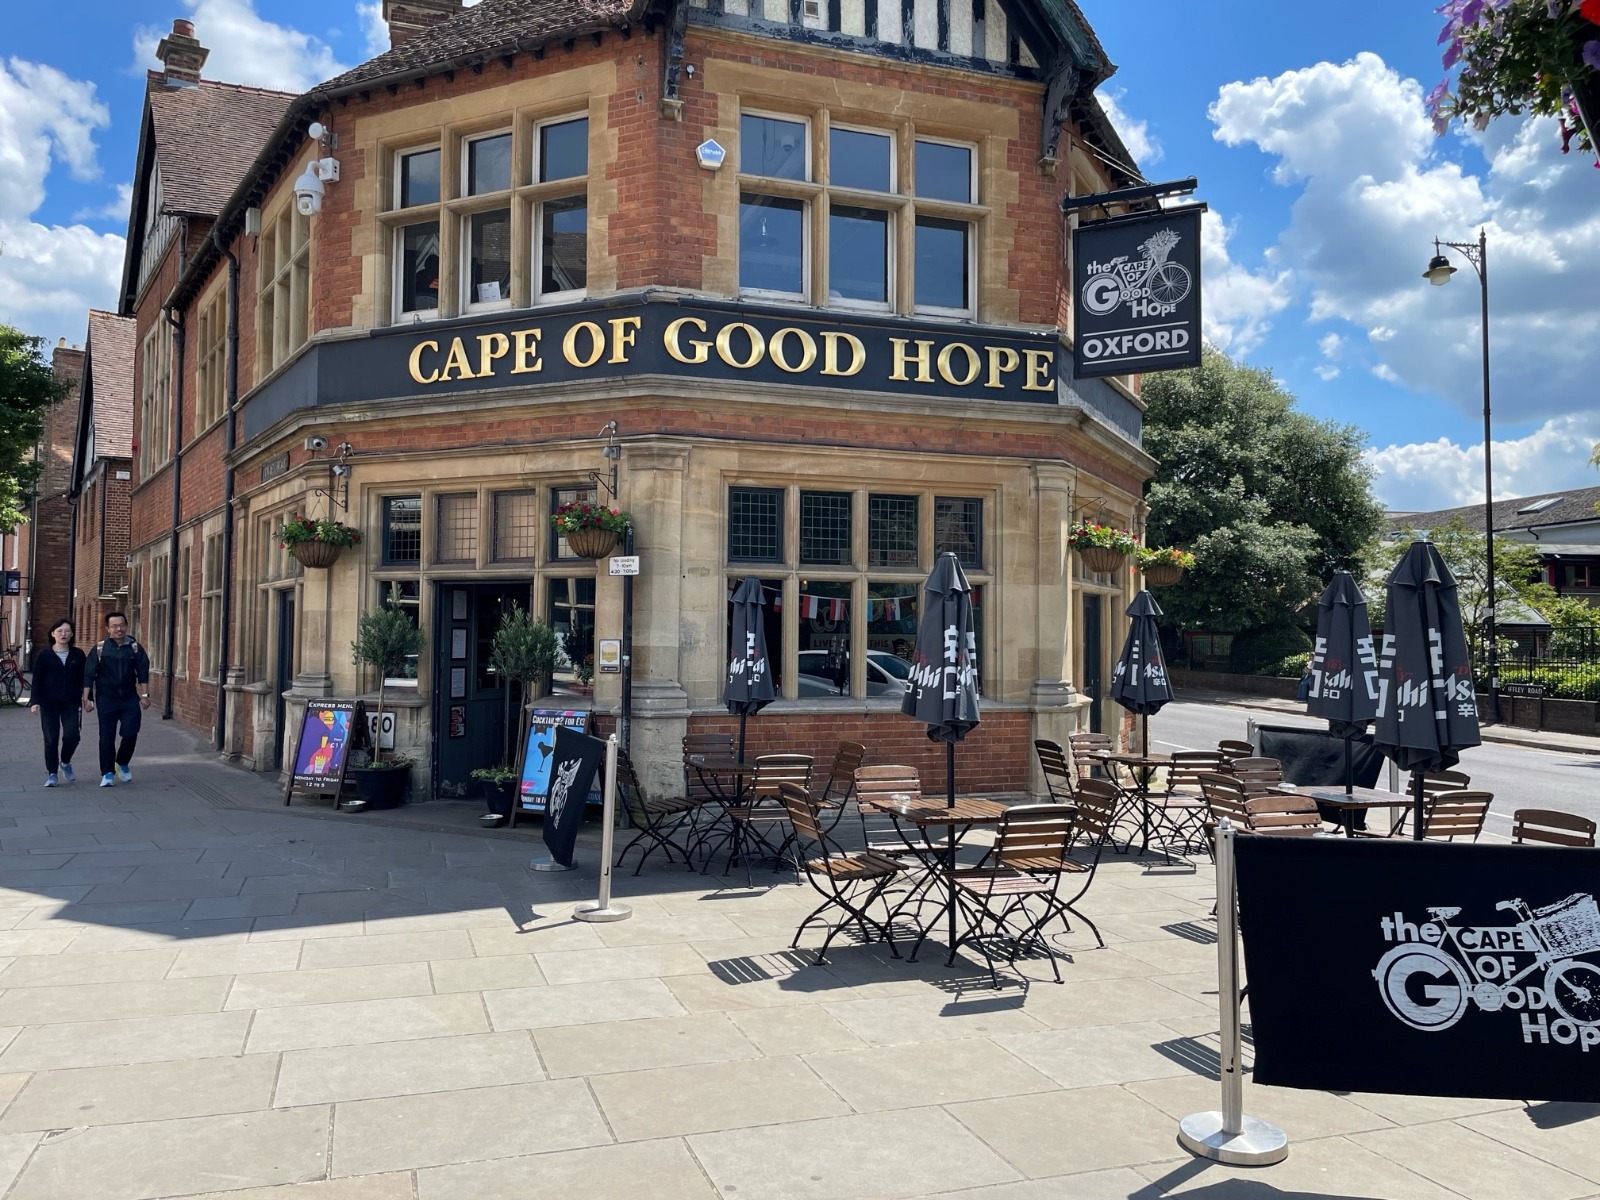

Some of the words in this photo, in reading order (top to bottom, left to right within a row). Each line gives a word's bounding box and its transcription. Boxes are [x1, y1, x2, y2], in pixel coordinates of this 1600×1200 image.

[1086, 260, 1112, 275] the
[1121, 261, 1149, 273] CAPE
[1126, 271, 1142, 282] OF
[408, 327, 543, 384] CAPE
[562, 316, 642, 368] OF
[663, 317, 867, 376] GOOD
[888, 337, 1055, 392] HOPE
[1082, 328, 1189, 359] OXFORD
[1380, 911, 1442, 943] the
[1456, 927, 1525, 950] CAPE
[1475, 955, 1517, 980] OF
